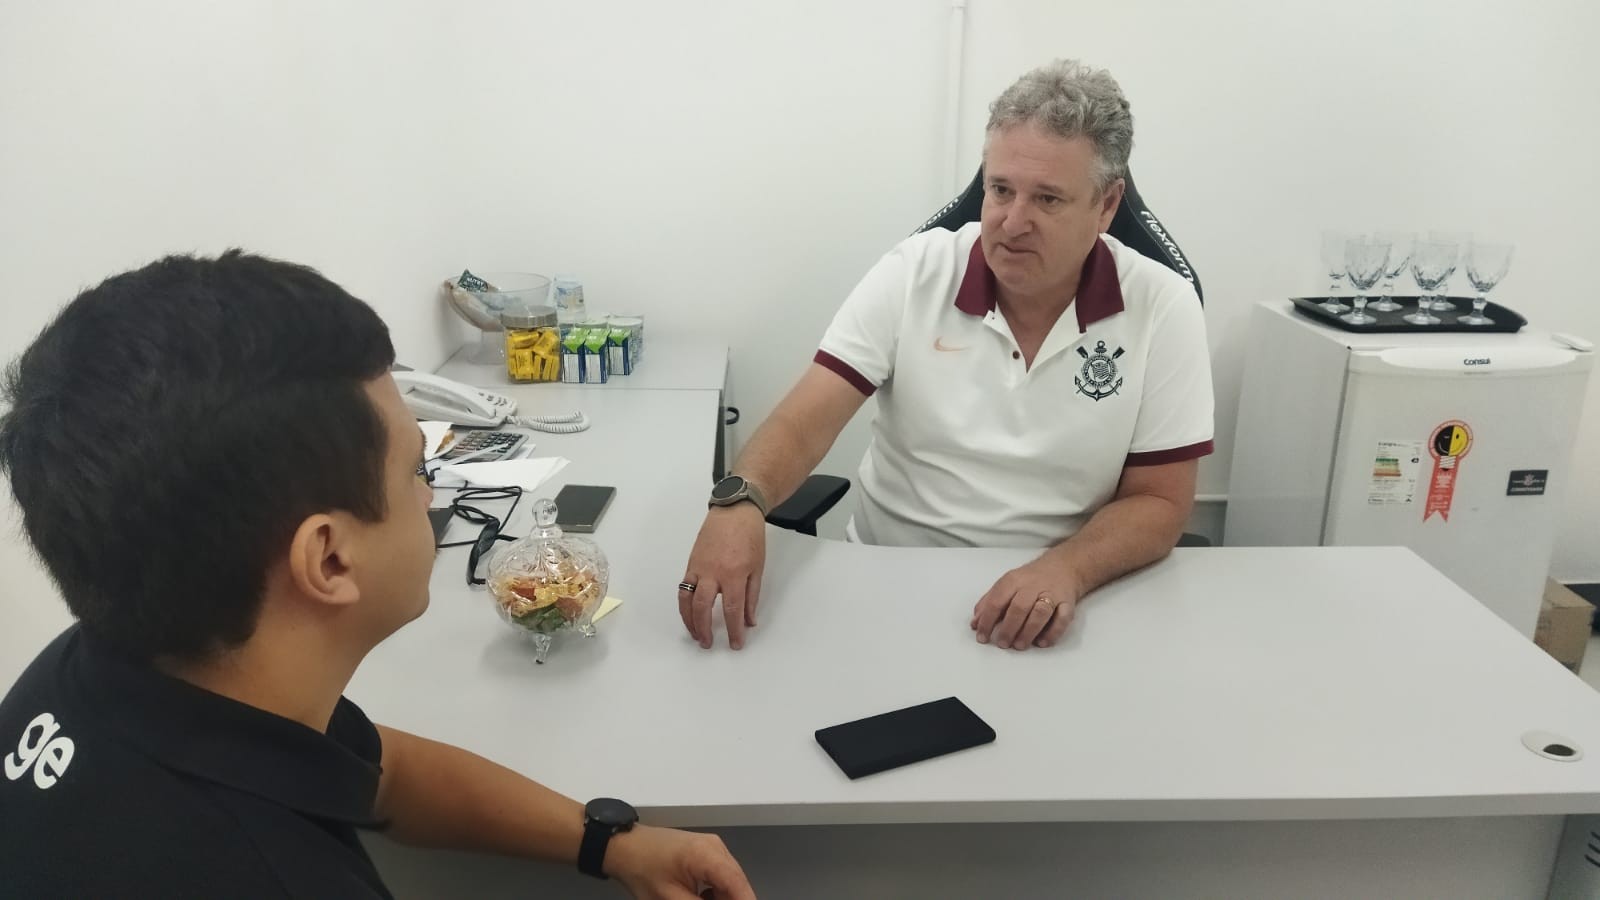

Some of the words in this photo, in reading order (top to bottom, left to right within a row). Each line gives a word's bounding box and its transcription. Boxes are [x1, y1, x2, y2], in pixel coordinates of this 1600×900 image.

[1140, 210, 1194, 281] Flexform
[1462, 357, 1491, 366] Consul
[4, 712, 76, 790] ge
